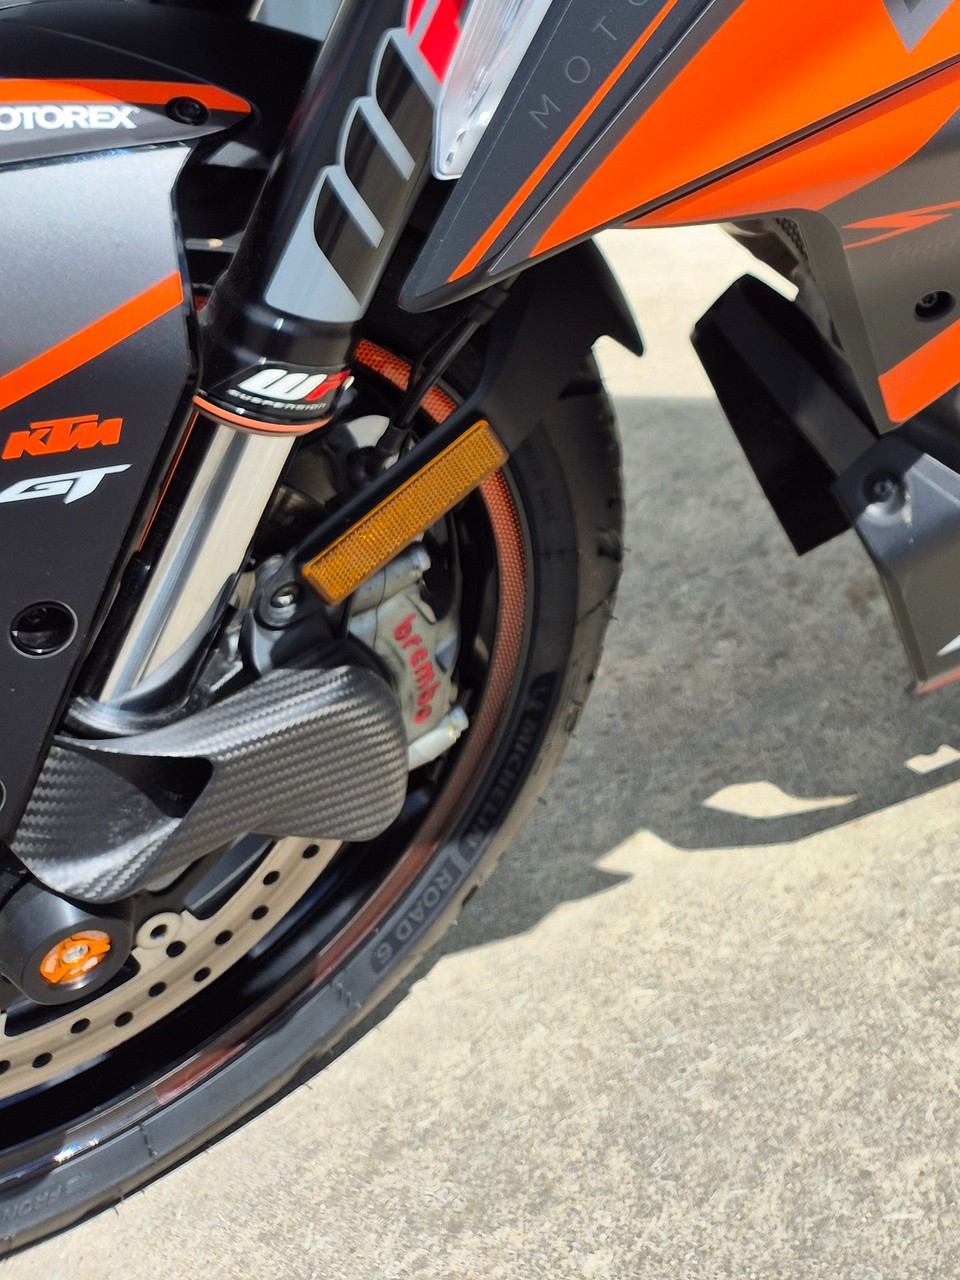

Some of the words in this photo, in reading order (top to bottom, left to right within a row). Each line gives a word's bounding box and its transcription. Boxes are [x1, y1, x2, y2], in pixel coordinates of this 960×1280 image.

[0, 104, 138, 131] OTOREX
[1, 414, 123, 460] KTM
[0, 463, 133, 505] GT
[394, 613, 441, 724] brembo
[465, 720, 542, 851] MICHELIN
[396, 867, 454, 942] ROAD
[375, 943, 393, 966] 6
